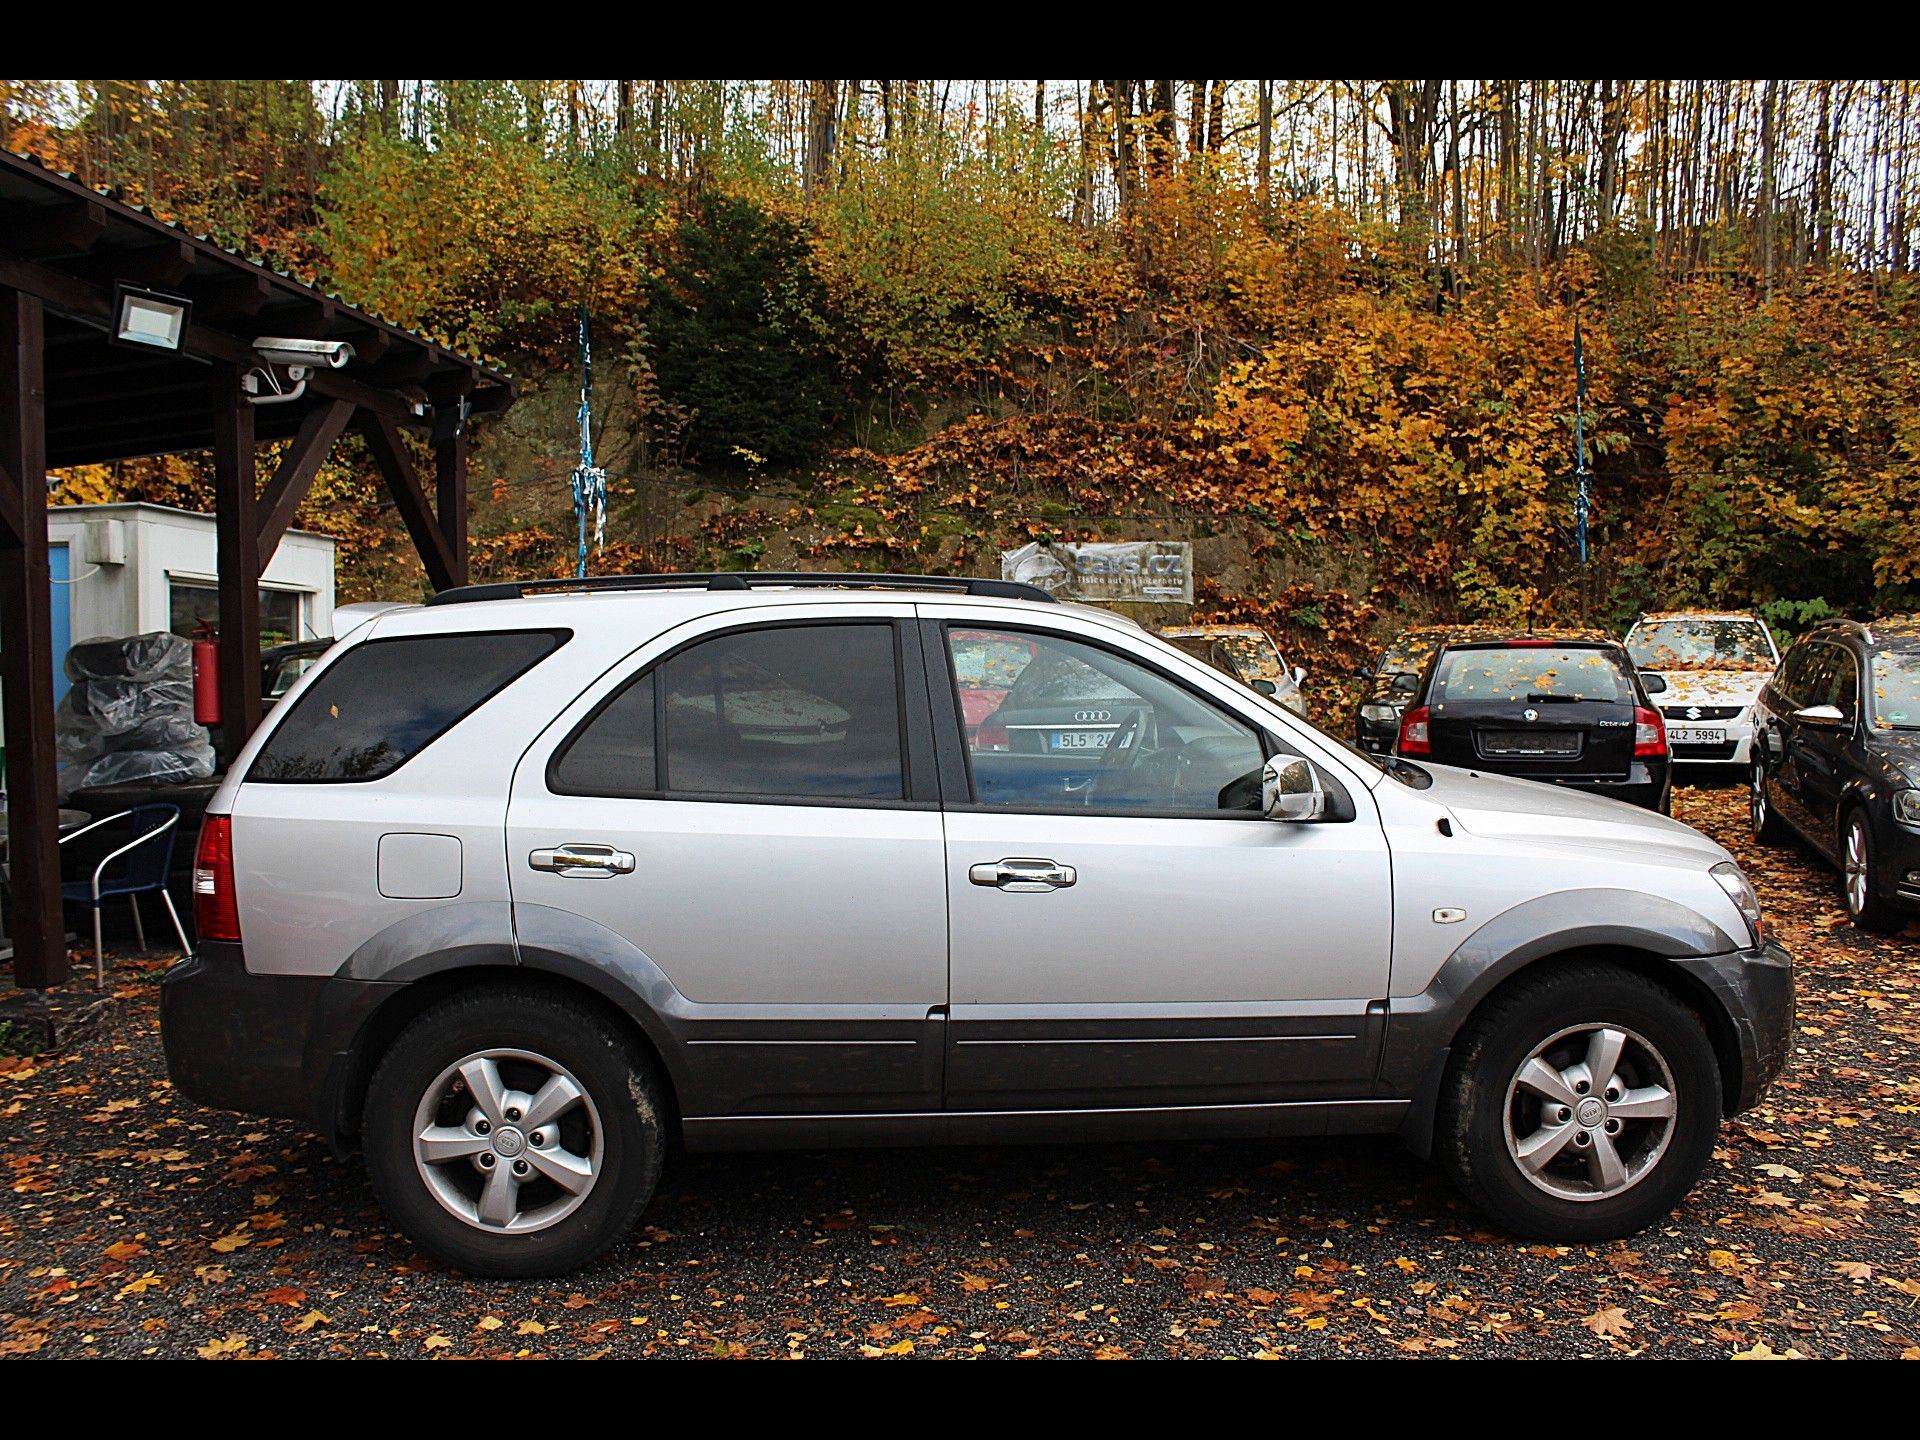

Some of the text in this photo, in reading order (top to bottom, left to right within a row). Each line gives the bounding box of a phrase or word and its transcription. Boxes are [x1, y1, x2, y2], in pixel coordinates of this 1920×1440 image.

[1062, 734, 1087, 747] 5L5
[1669, 730, 1720, 740] 4L2 5994
